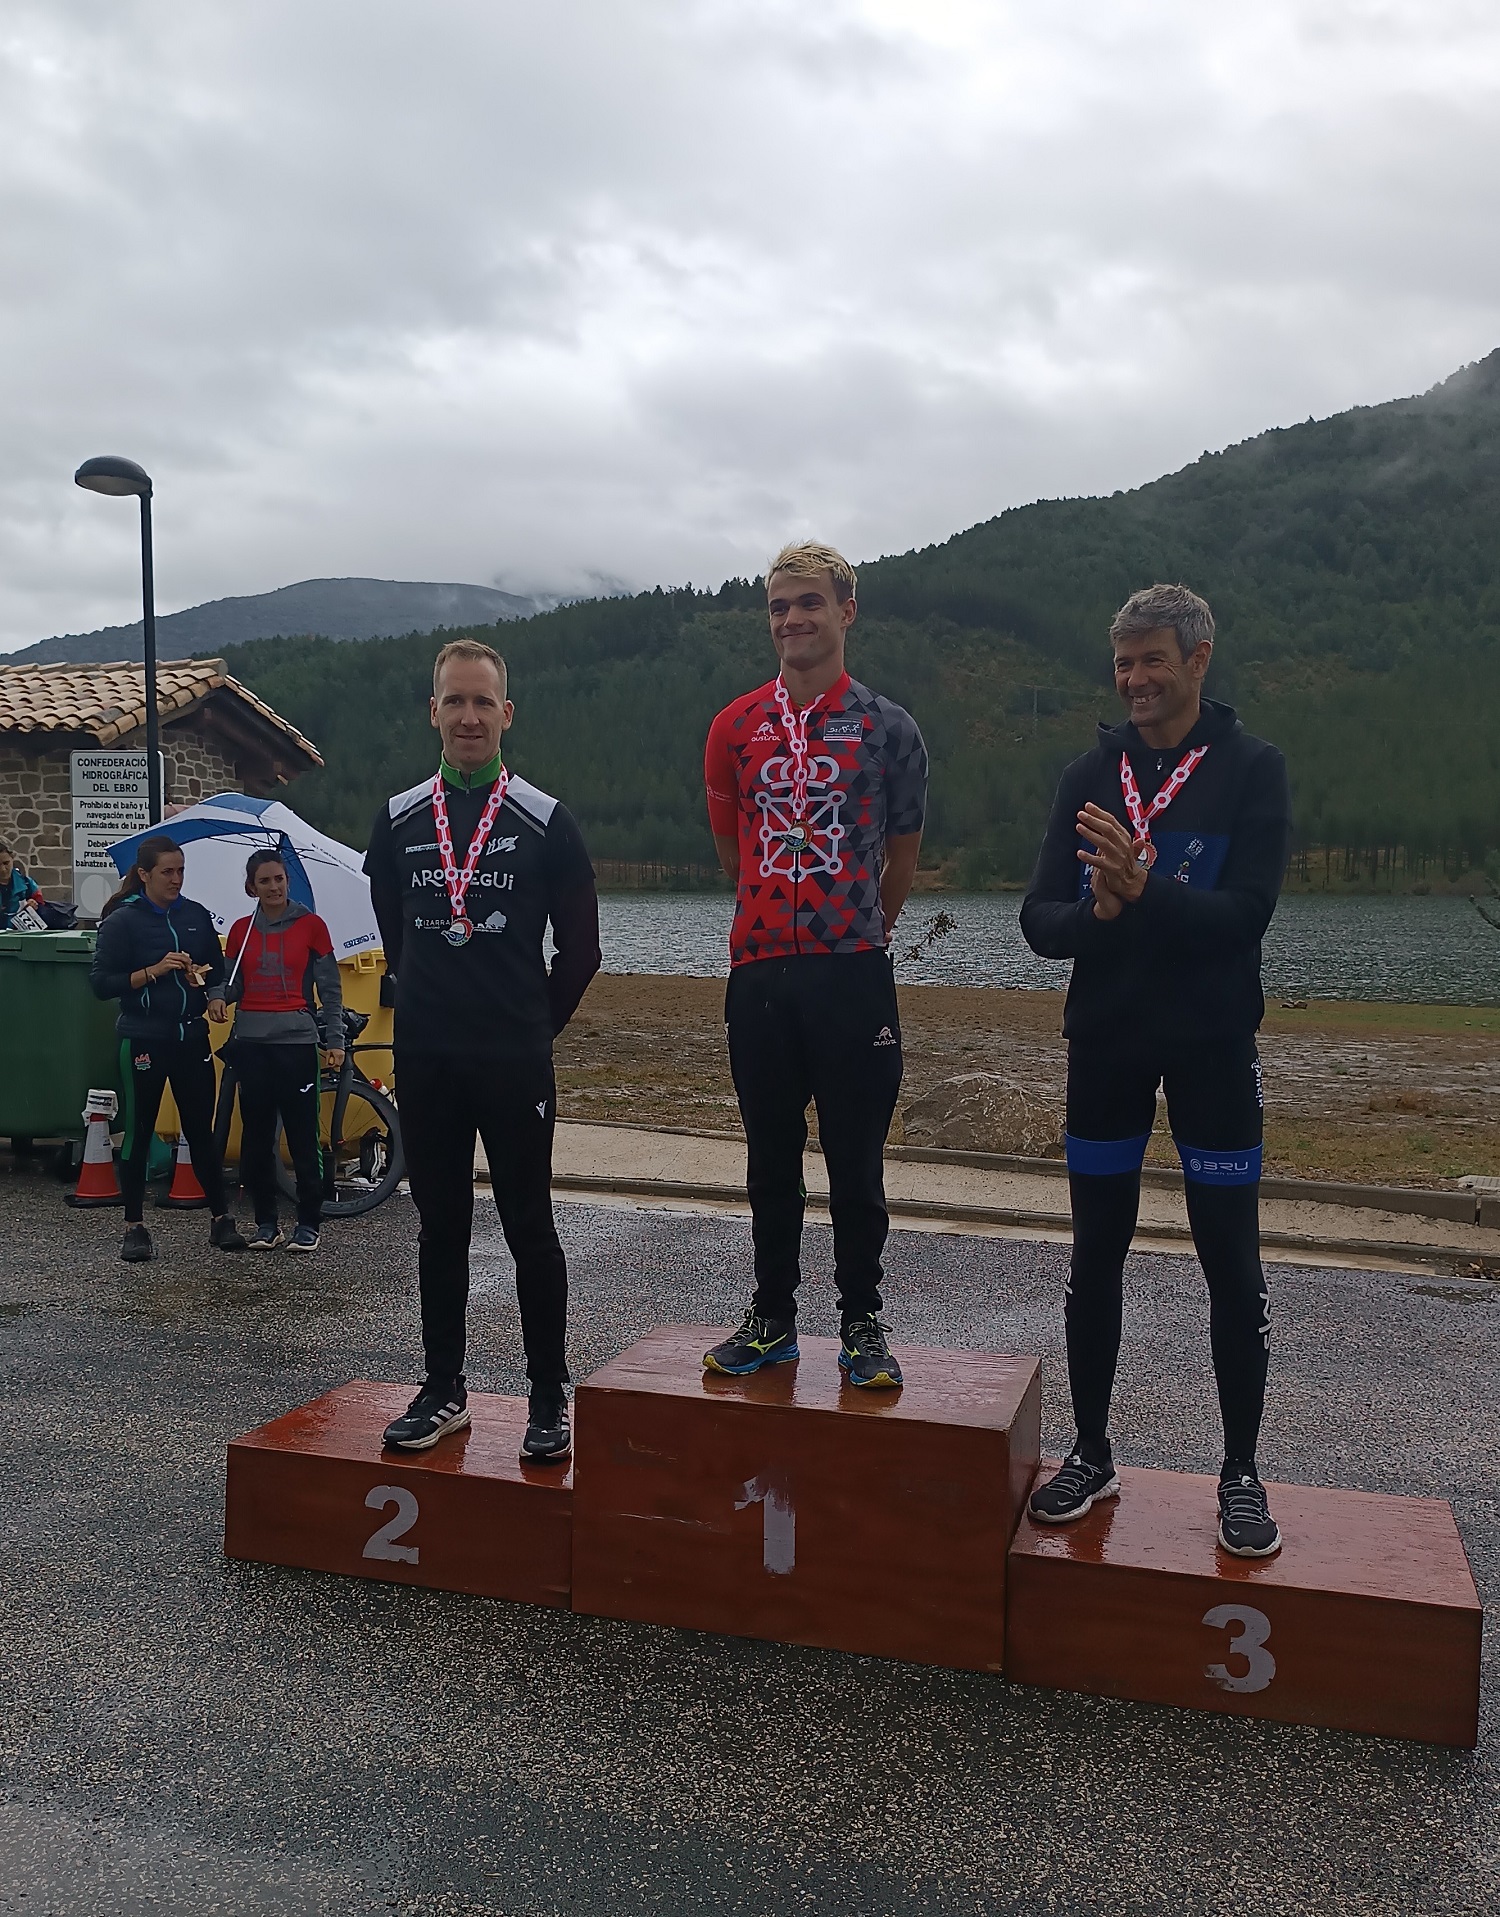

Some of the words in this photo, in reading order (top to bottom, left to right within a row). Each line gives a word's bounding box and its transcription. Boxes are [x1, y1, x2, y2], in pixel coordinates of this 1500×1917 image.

[77, 757, 148, 767] CONFEDERACIÓ
[82, 769, 148, 780] HIDROGRÁFICA
[93, 783, 110, 793] DEL
[114, 783, 138, 793] EBRO
[80, 800, 112, 809] Prohibido
[113, 801, 119, 809] el
[120, 801, 138, 810] baño
[139, 803, 144, 811] y
[86, 811, 124, 820] navegación
[125, 812, 133, 820] en
[134, 811, 145, 820] las
[75, 820, 119, 830] proximidades
[121, 821, 129, 830] de
[130, 821, 137, 830] la
[138, 823, 149, 831] pre
[84, 850, 111, 859] presare
[362, 1485, 420, 1565] 2
[734, 1475, 796, 1575] 1
[1201, 1603, 1277, 1694] 3
